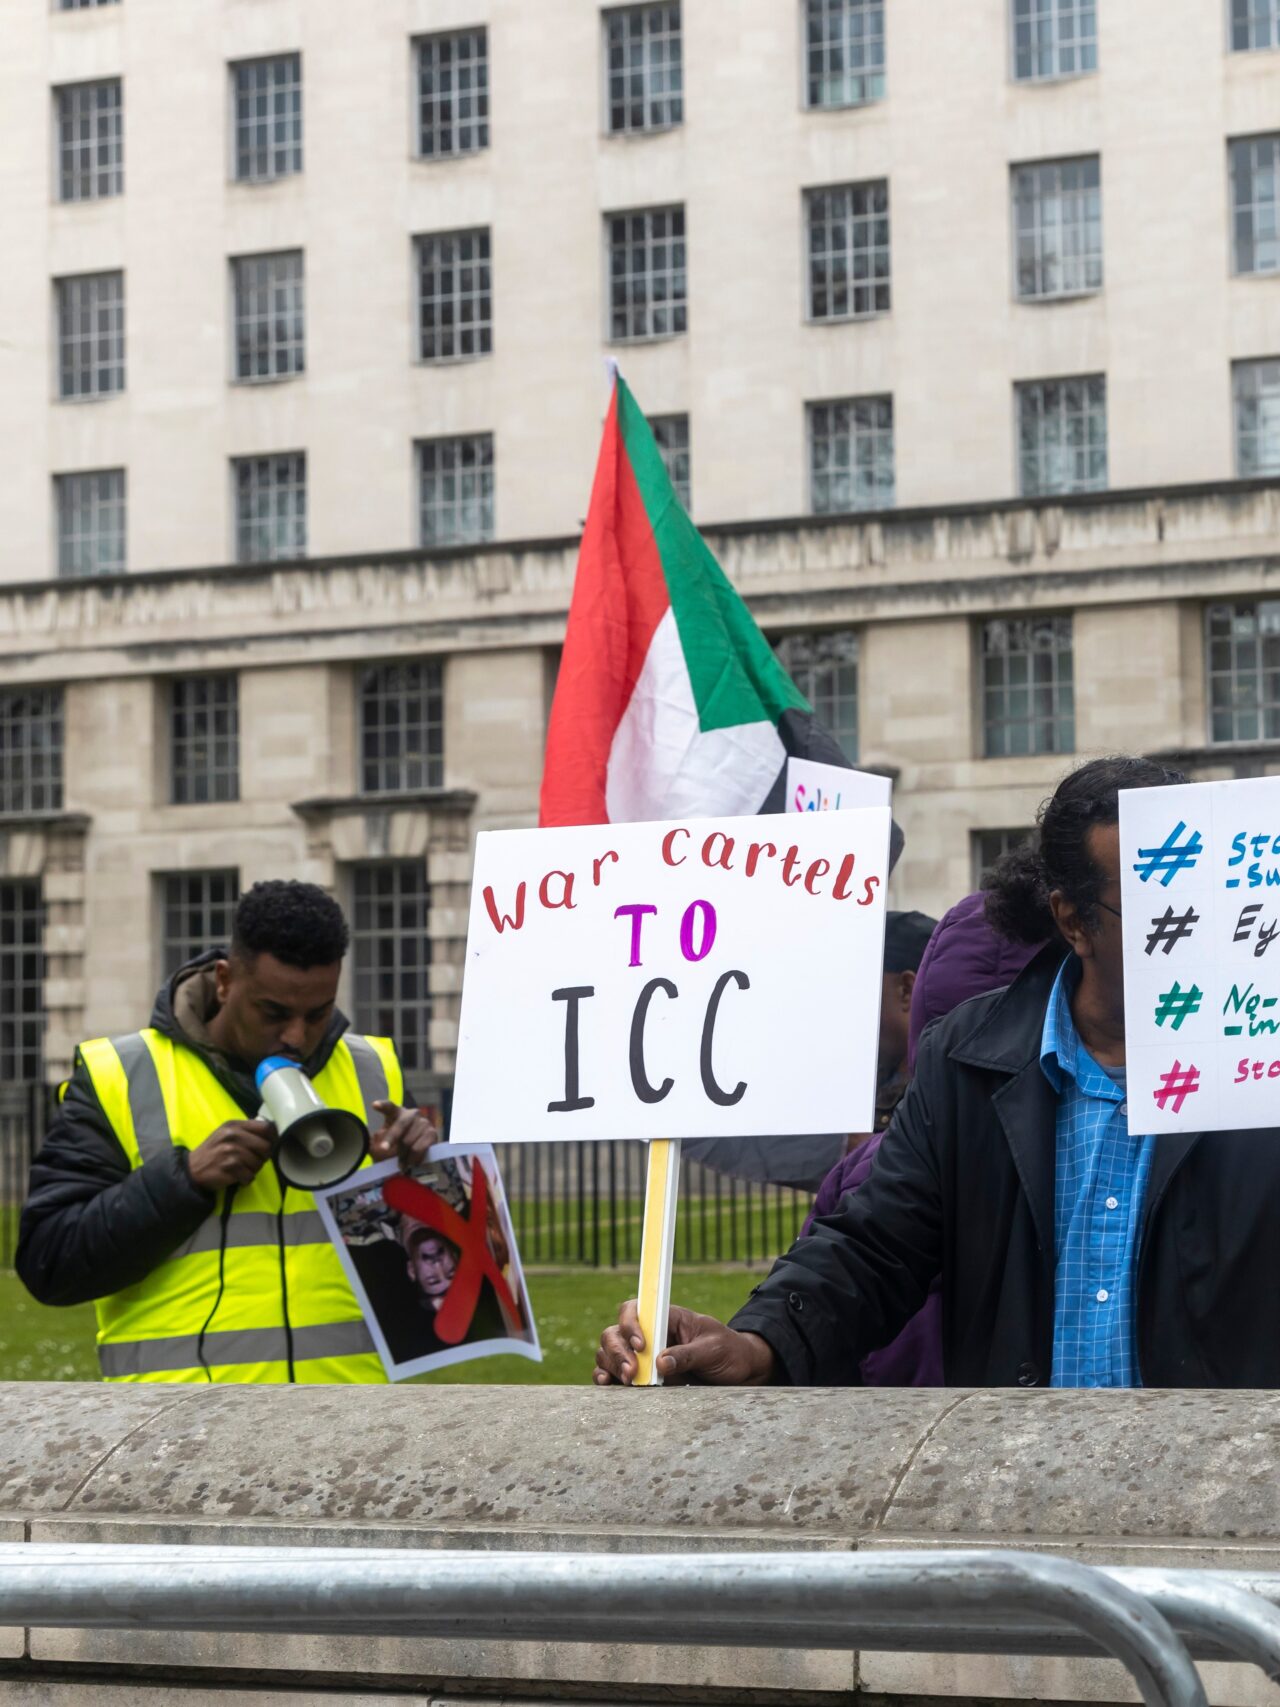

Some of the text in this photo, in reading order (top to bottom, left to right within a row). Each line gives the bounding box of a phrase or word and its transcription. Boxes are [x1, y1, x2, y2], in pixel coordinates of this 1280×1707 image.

[1132, 820, 1204, 888] #
[613, 899, 718, 968] TO
[1143, 904, 1201, 957] #
[1154, 980, 1204, 1032] #
[546, 969, 751, 1113] ICC
[1152, 1059, 1201, 1114] #
